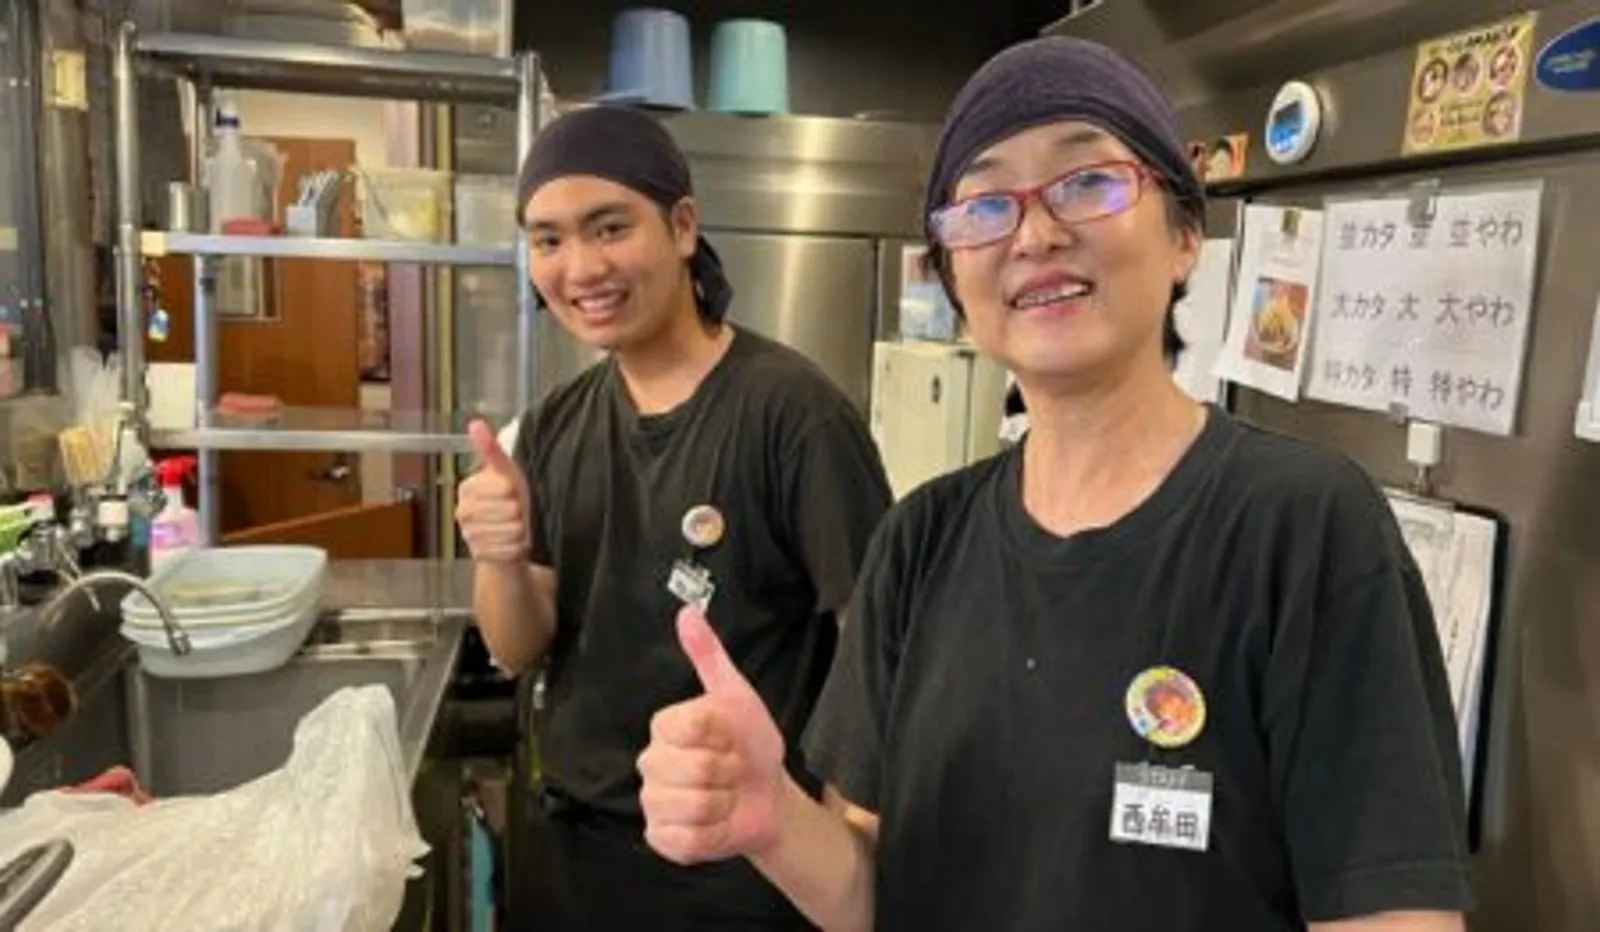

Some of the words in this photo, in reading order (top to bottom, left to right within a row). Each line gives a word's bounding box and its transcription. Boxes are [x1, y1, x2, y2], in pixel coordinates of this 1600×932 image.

[1330, 293, 1384, 319] 大カタ
[1396, 293, 1420, 321] 大
[1435, 293, 1515, 327] 大やわ
